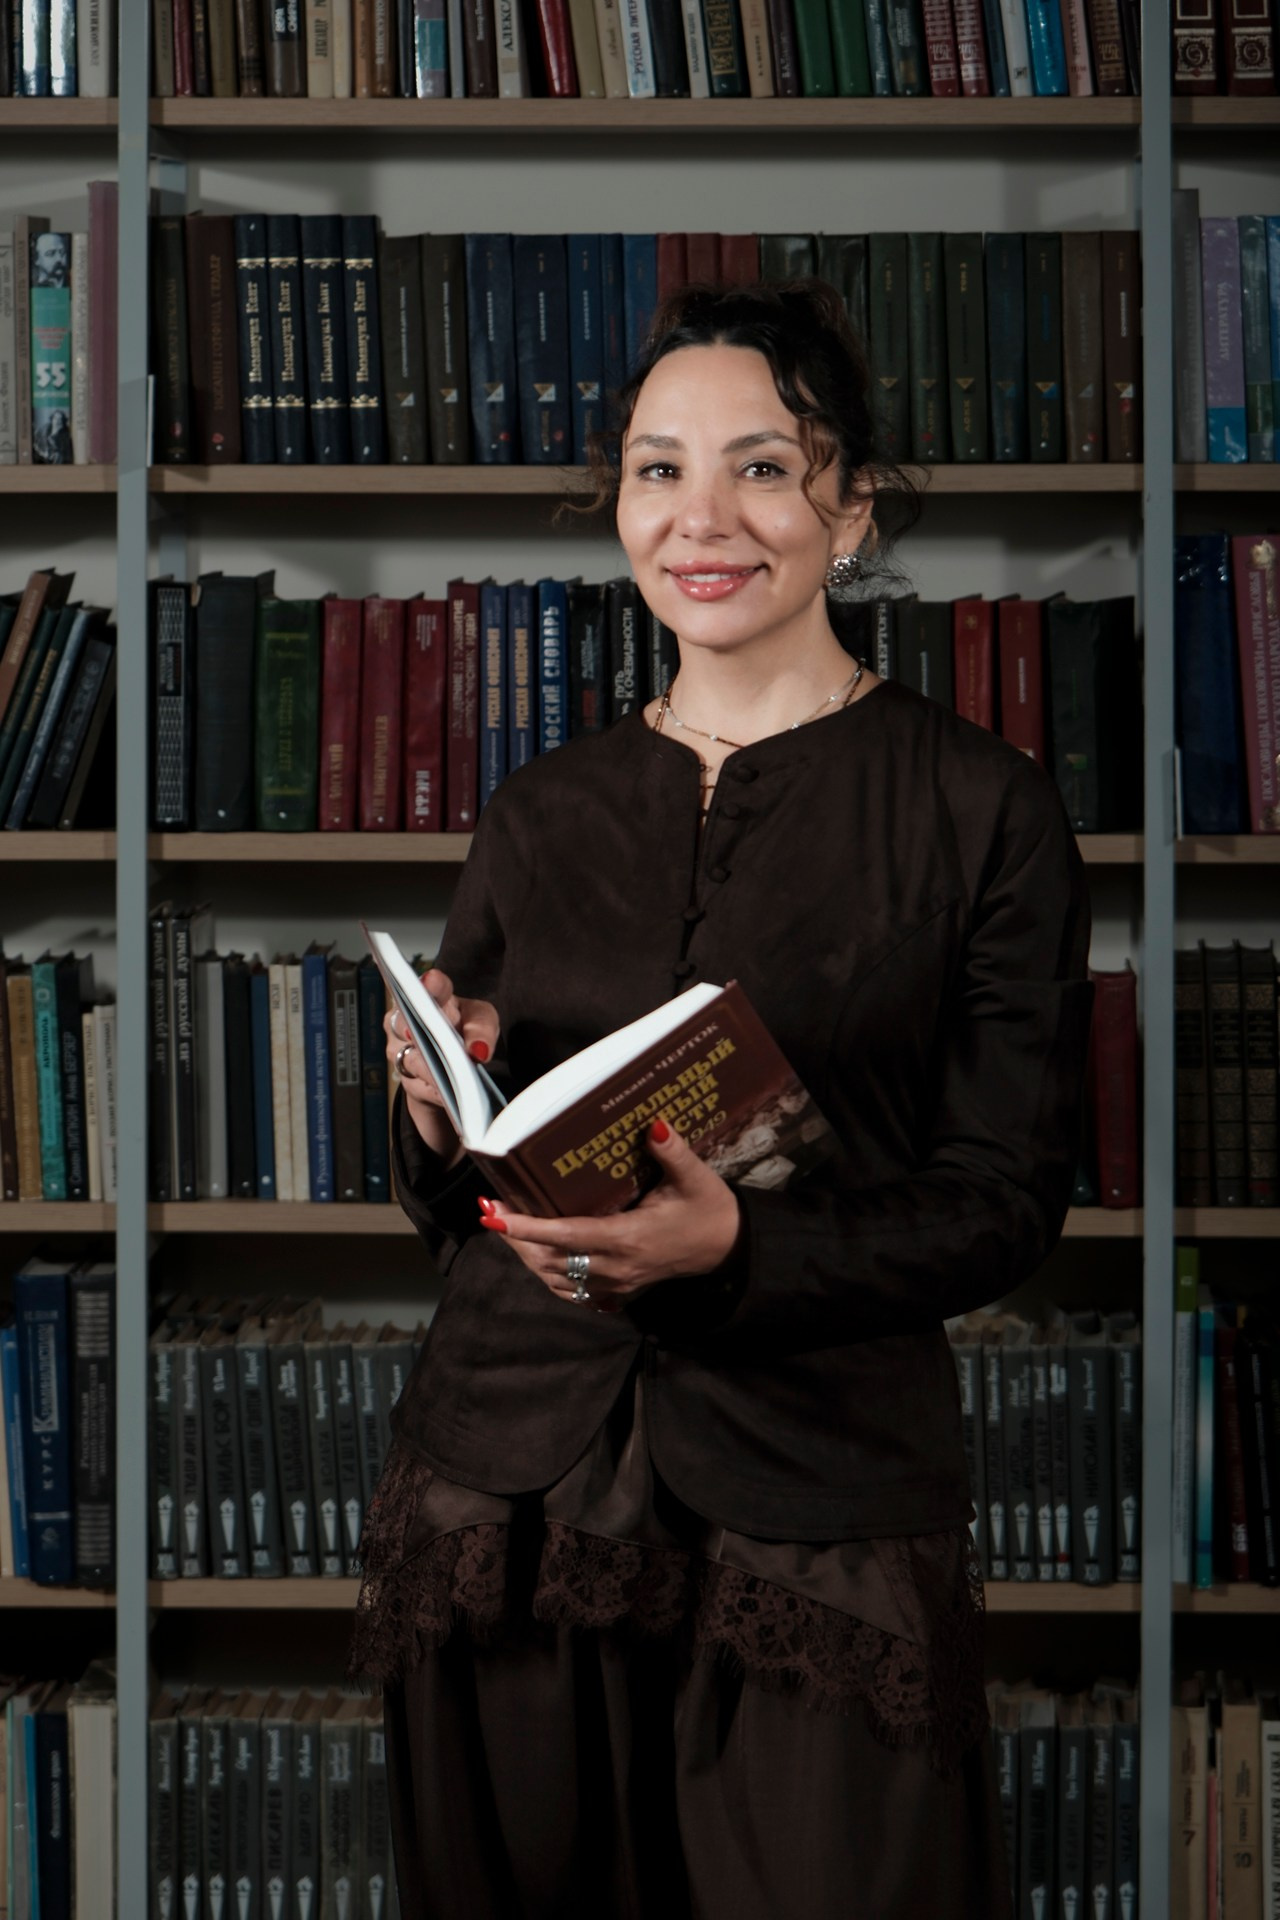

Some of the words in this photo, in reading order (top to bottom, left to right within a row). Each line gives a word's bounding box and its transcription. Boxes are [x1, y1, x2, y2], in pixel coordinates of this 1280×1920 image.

[245, 281, 259, 314] Кант
[278, 280, 292, 313] Кант
[317, 281, 332, 314] Кант
[353, 279, 367, 313] Кант
[1217, 281, 1230, 361] ЛИТЕРАТУРА
[36, 362, 67, 389] 55
[1249, 571, 1266, 640] ПРИСЛОВЬЯ
[464, 612, 476, 646] ИДЕЙ
[542, 606, 561, 678] СЛОВАРЬ
[622, 606, 635, 689] ОЧЕВИДНОСТИ
[486, 627, 501, 686] ФИЛОСОФИЯ
[514, 627, 529, 686] ФИЛОСОФИЯ
[614, 670, 625, 699] ПУТЬ
[623, 689, 635, 699] К
[1253, 650, 1270, 719] ПОГОВОРКИ
[487, 687, 501, 729] РУССКАЯ
[515, 687, 529, 729] РУССКАЯ
[1258, 720, 1275, 800] ПОСЛОВИЦЫ,
[153, 932, 167, 972] думы
[176, 932, 190, 973] думы
[152, 978, 169, 1038] русской
[174, 977, 192, 1038] русской
[271, 983, 281, 1010] ВЕХИ
[290, 987, 300, 1013] ВЕХИ
[63, 1032, 77, 1072] БЕРЗЕР
[314, 1032, 326, 1078] истории
[655, 1021, 719, 1072] ЧЕРТОК
[65, 1075, 77, 1100] Анна
[314, 1079, 328, 1142] философия
[552, 1036, 737, 1179] ЦЕНТРАЛЬНЫЙ
[65, 1104, 80, 1150] ЛИПКИН
[316, 1143, 328, 1185] Русская
[211, 1398, 231, 1435] БОР
[40, 1435, 55, 1491] КУРС
[215, 1438, 235, 1496] НИЛЬС
[339, 1421, 354, 1484] ГАШЕК
[1035, 1416, 1052, 1486] МОЛЬЕР
[1079, 1423, 1098, 1498] НИКОЛАЙ
[267, 1787, 283, 1870] ПИСАРЕВ
[1093, 1791, 1107, 1872] ЧКАЛОВ
[1182, 1829, 1195, 1847] 7
